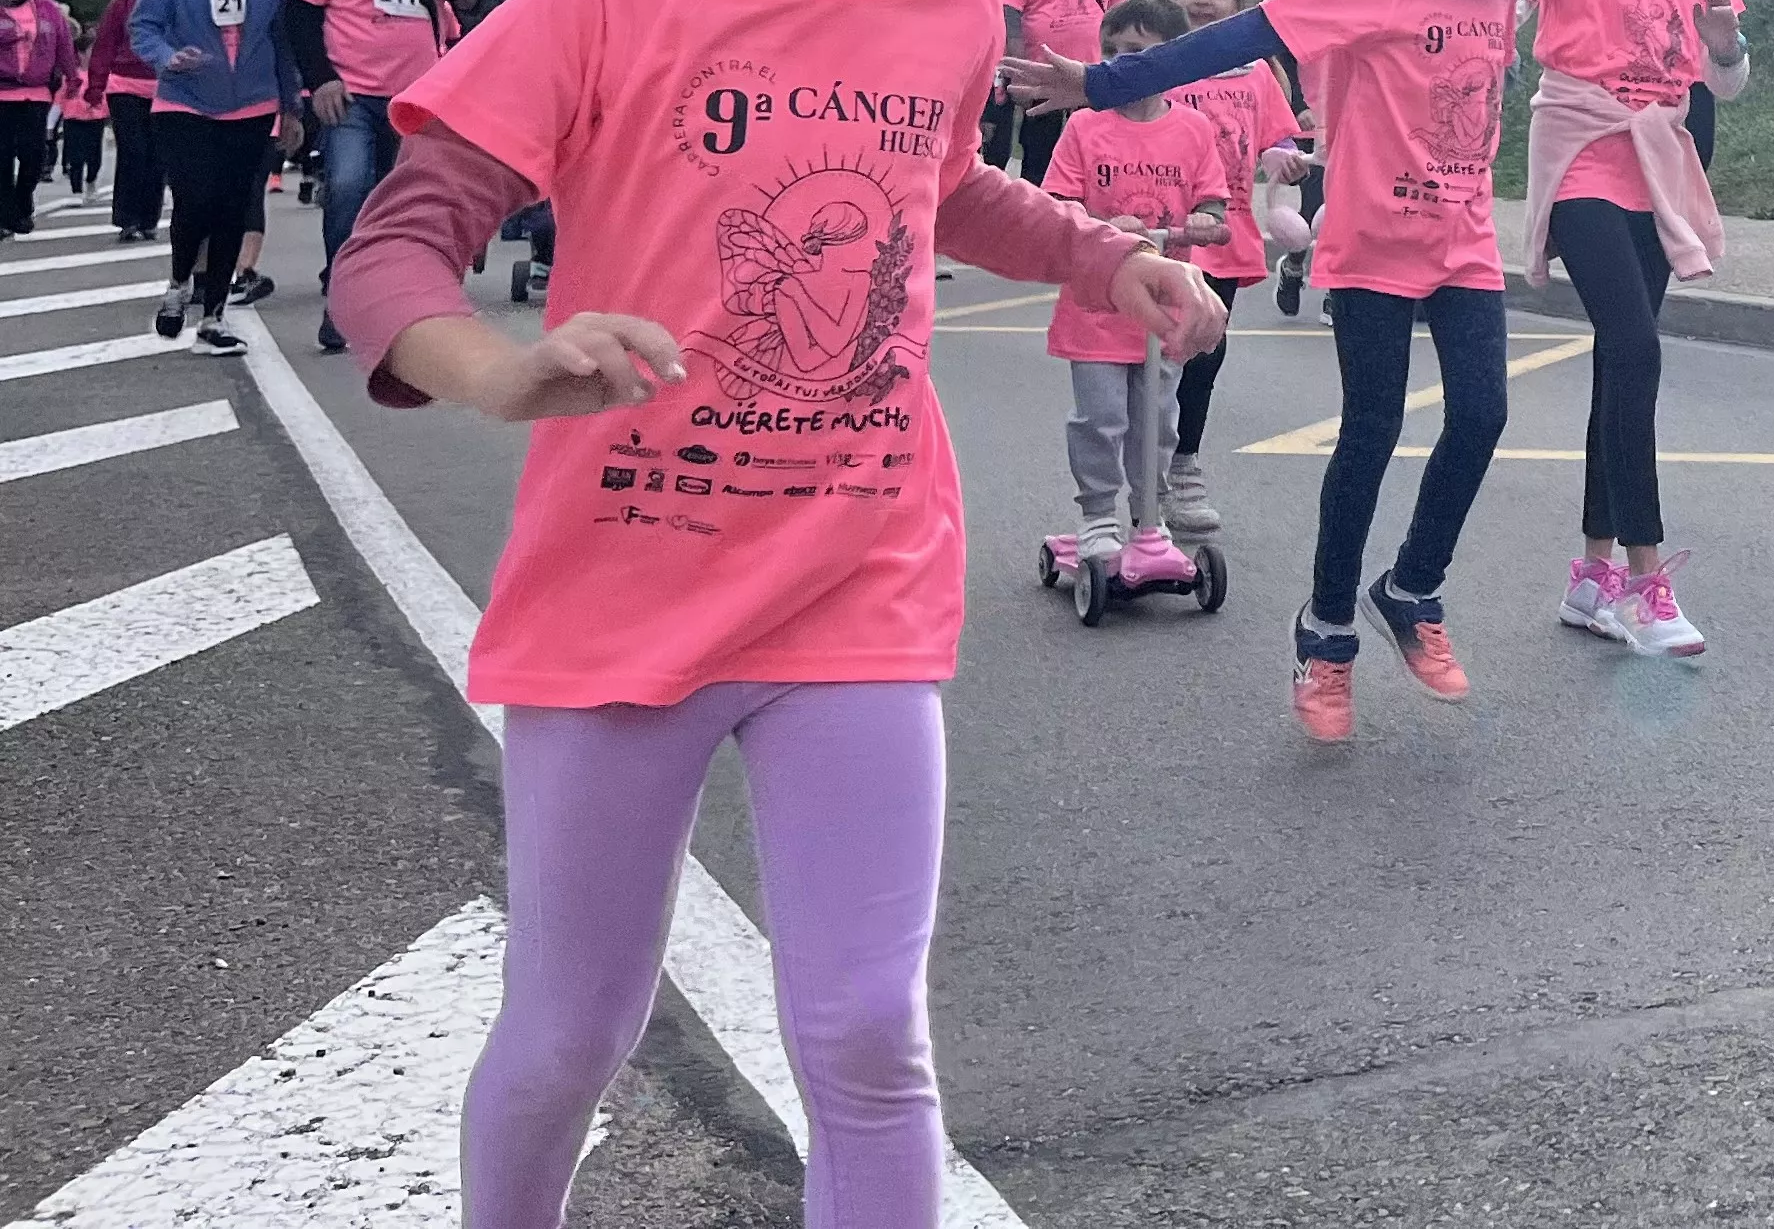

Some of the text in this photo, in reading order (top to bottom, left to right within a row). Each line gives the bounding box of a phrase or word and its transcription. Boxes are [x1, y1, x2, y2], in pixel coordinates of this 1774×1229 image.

[1457, 17, 1504, 37] CÁNCE
[682, 59, 755, 100] CONTRA
[758, 65, 777, 85] EL
[703, 80, 945, 155] 9ª CÁNCER
[879, 129, 943, 159] HUESC
[1123, 160, 1181, 178] CÁNCER
[752, 369, 790, 391] TODAS
[795, 385, 819, 398] TUS
[691, 401, 910, 434] QUIÉRETE MUCHO
